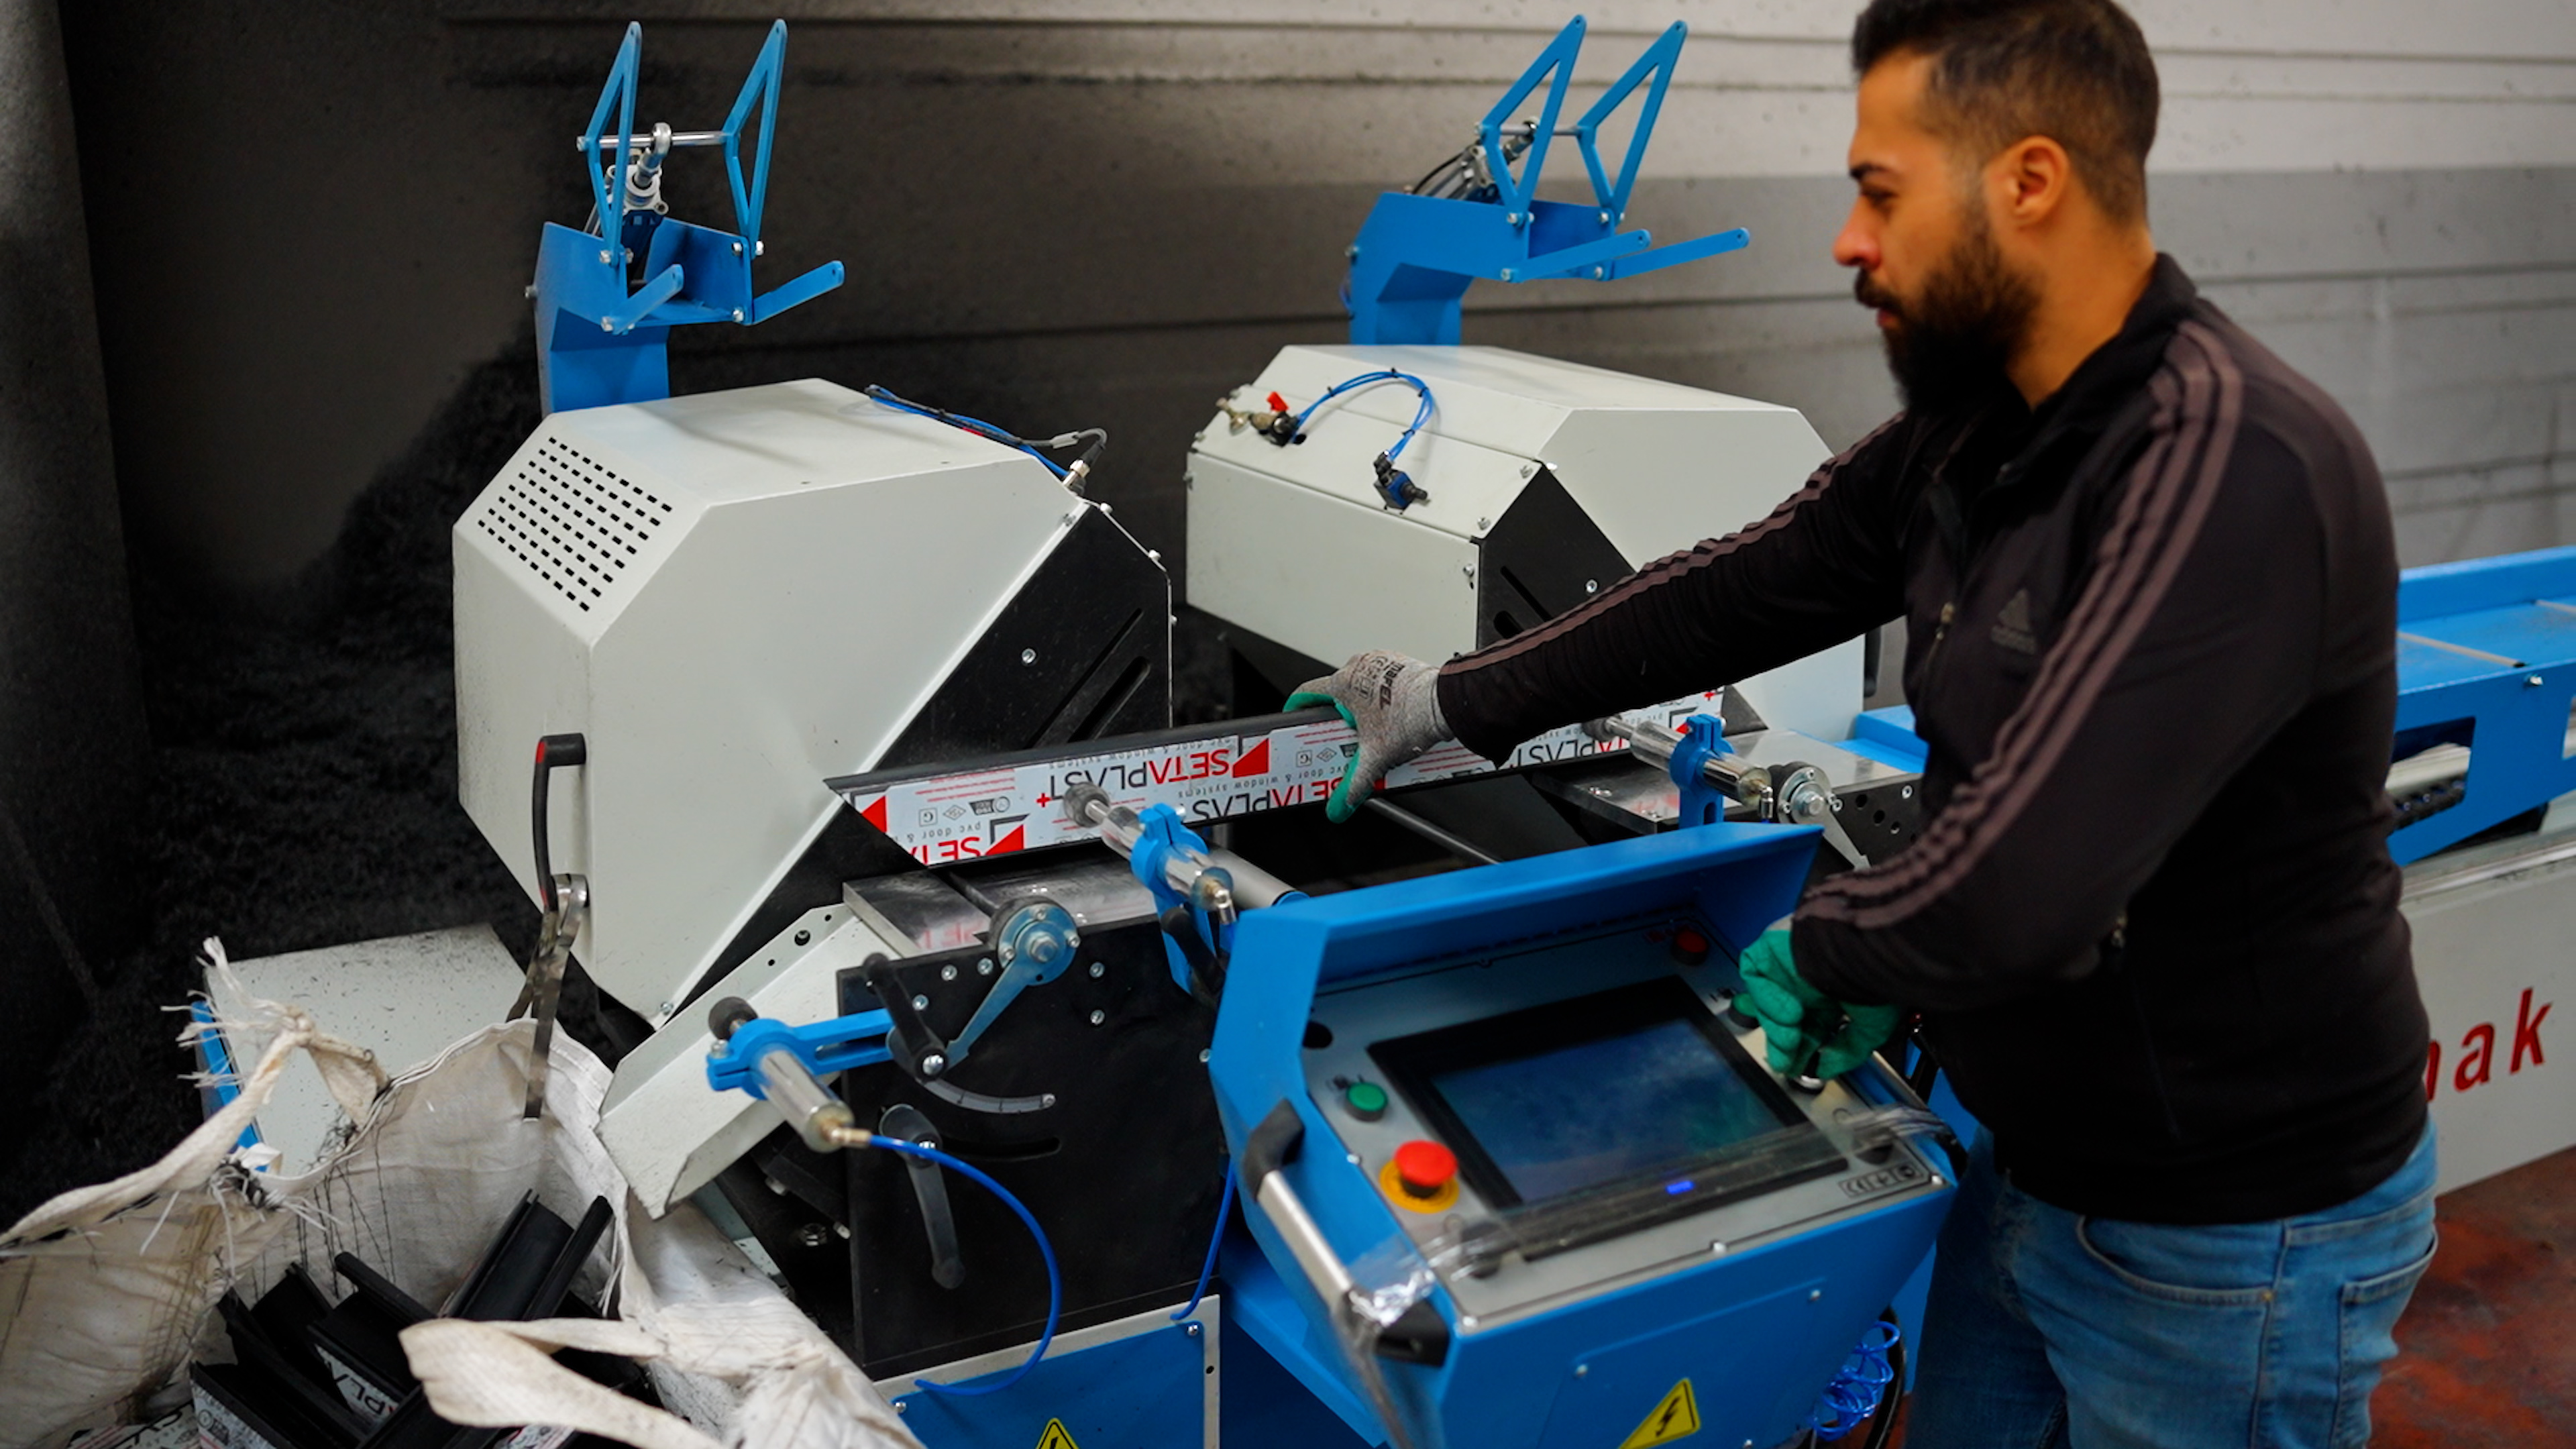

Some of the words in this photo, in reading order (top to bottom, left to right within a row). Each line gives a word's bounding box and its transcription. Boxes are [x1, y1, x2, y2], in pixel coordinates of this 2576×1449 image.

[1285, 773, 1293, 782] &
[1298, 769, 1324, 779] door
[1234, 775, 1279, 789] window
[1178, 784, 1228, 798] systems
[922, 826, 952, 839] door
[960, 820, 981, 834] pvc
